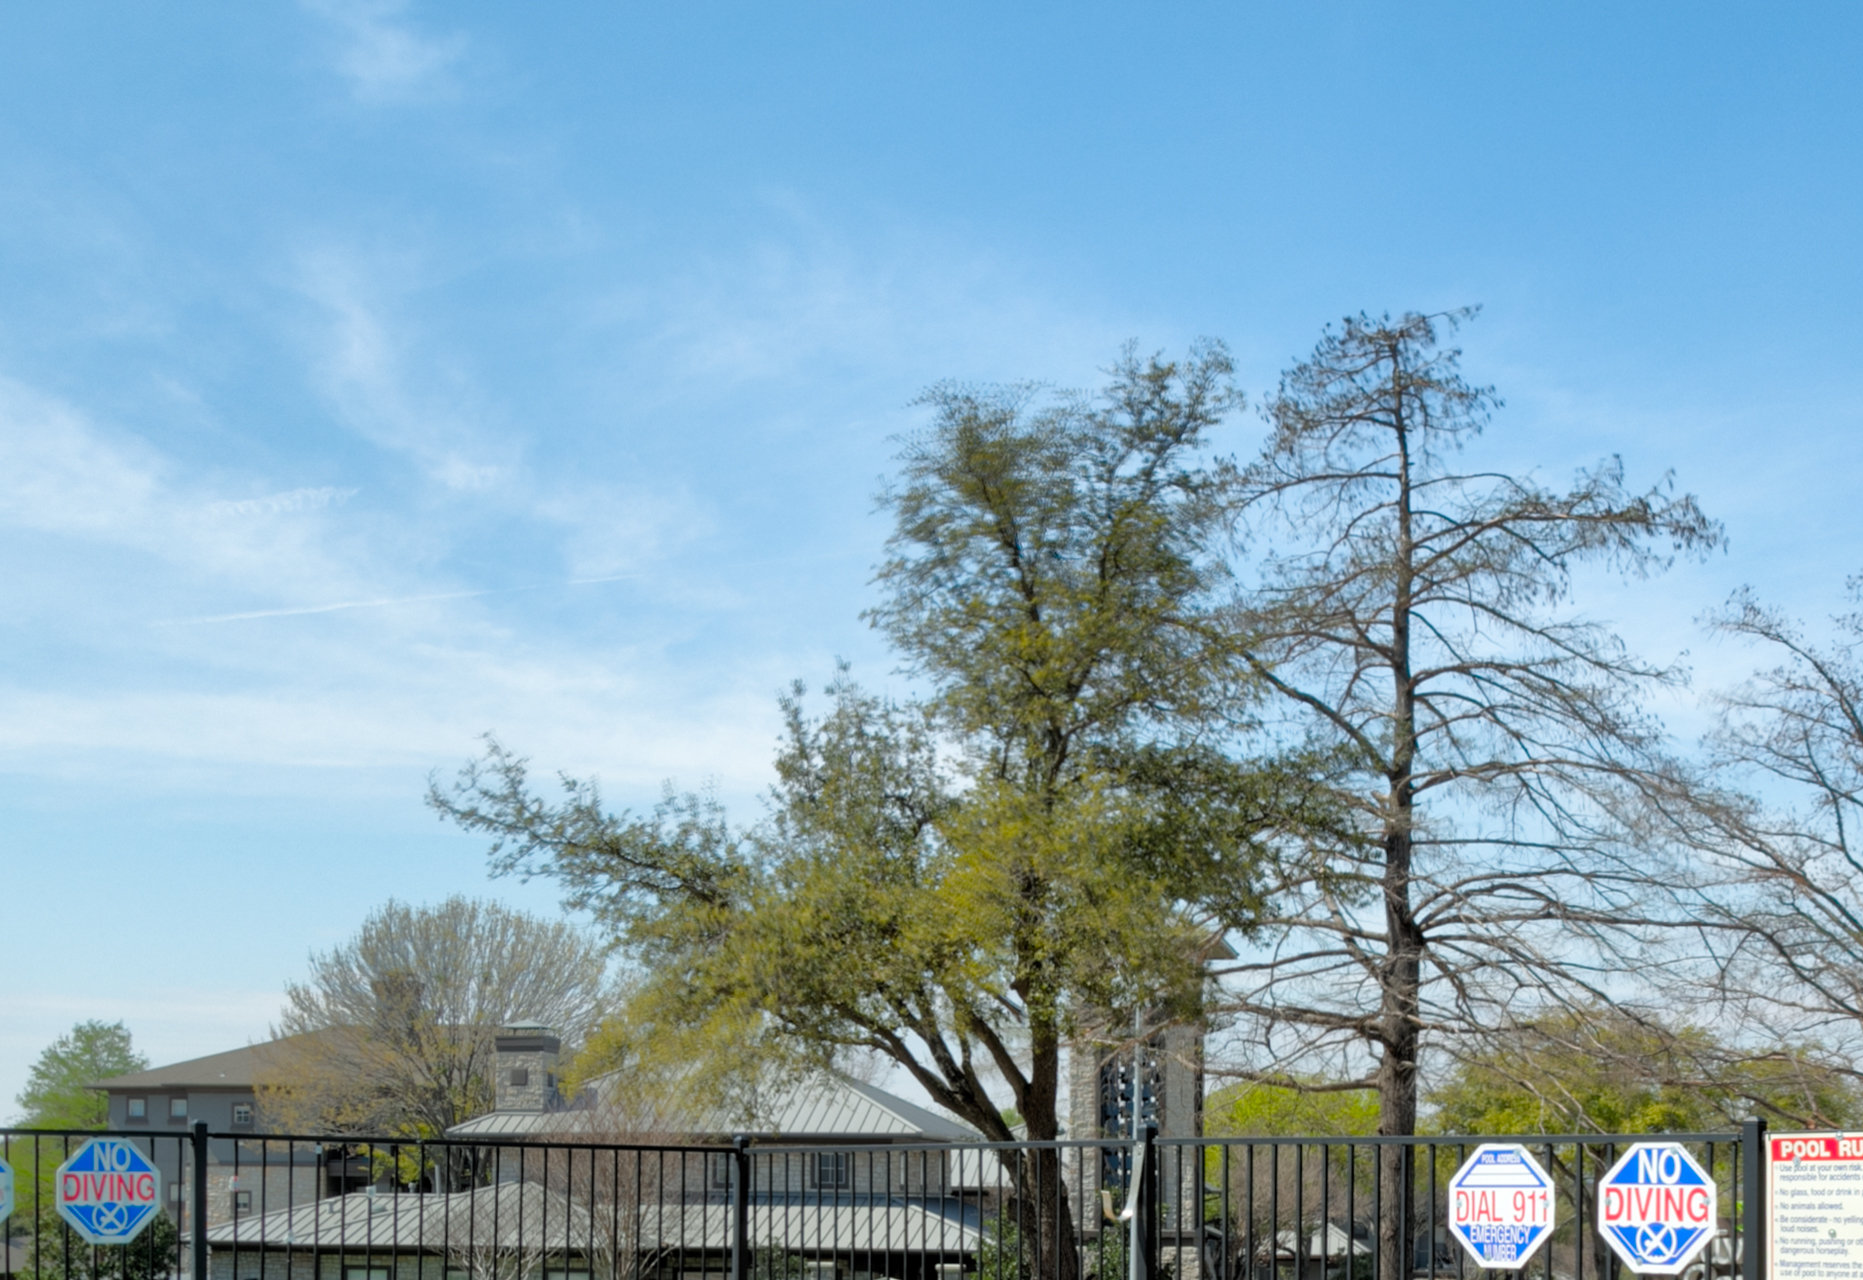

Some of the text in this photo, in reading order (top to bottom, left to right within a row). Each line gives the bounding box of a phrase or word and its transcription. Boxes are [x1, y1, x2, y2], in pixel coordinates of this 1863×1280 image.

[94, 1142, 131, 1172] NO
[1781, 1140, 1830, 1158] POOL
[1638, 1148, 1682, 1185] NO
[63, 1173, 155, 1202] DIVING
[1456, 1190, 1548, 1222] DIAL 911
[1605, 1188, 1708, 1222] DIVING
[1470, 1226, 1531, 1244] EMERGENCY
[1483, 1244, 1517, 1262] NUMBER
